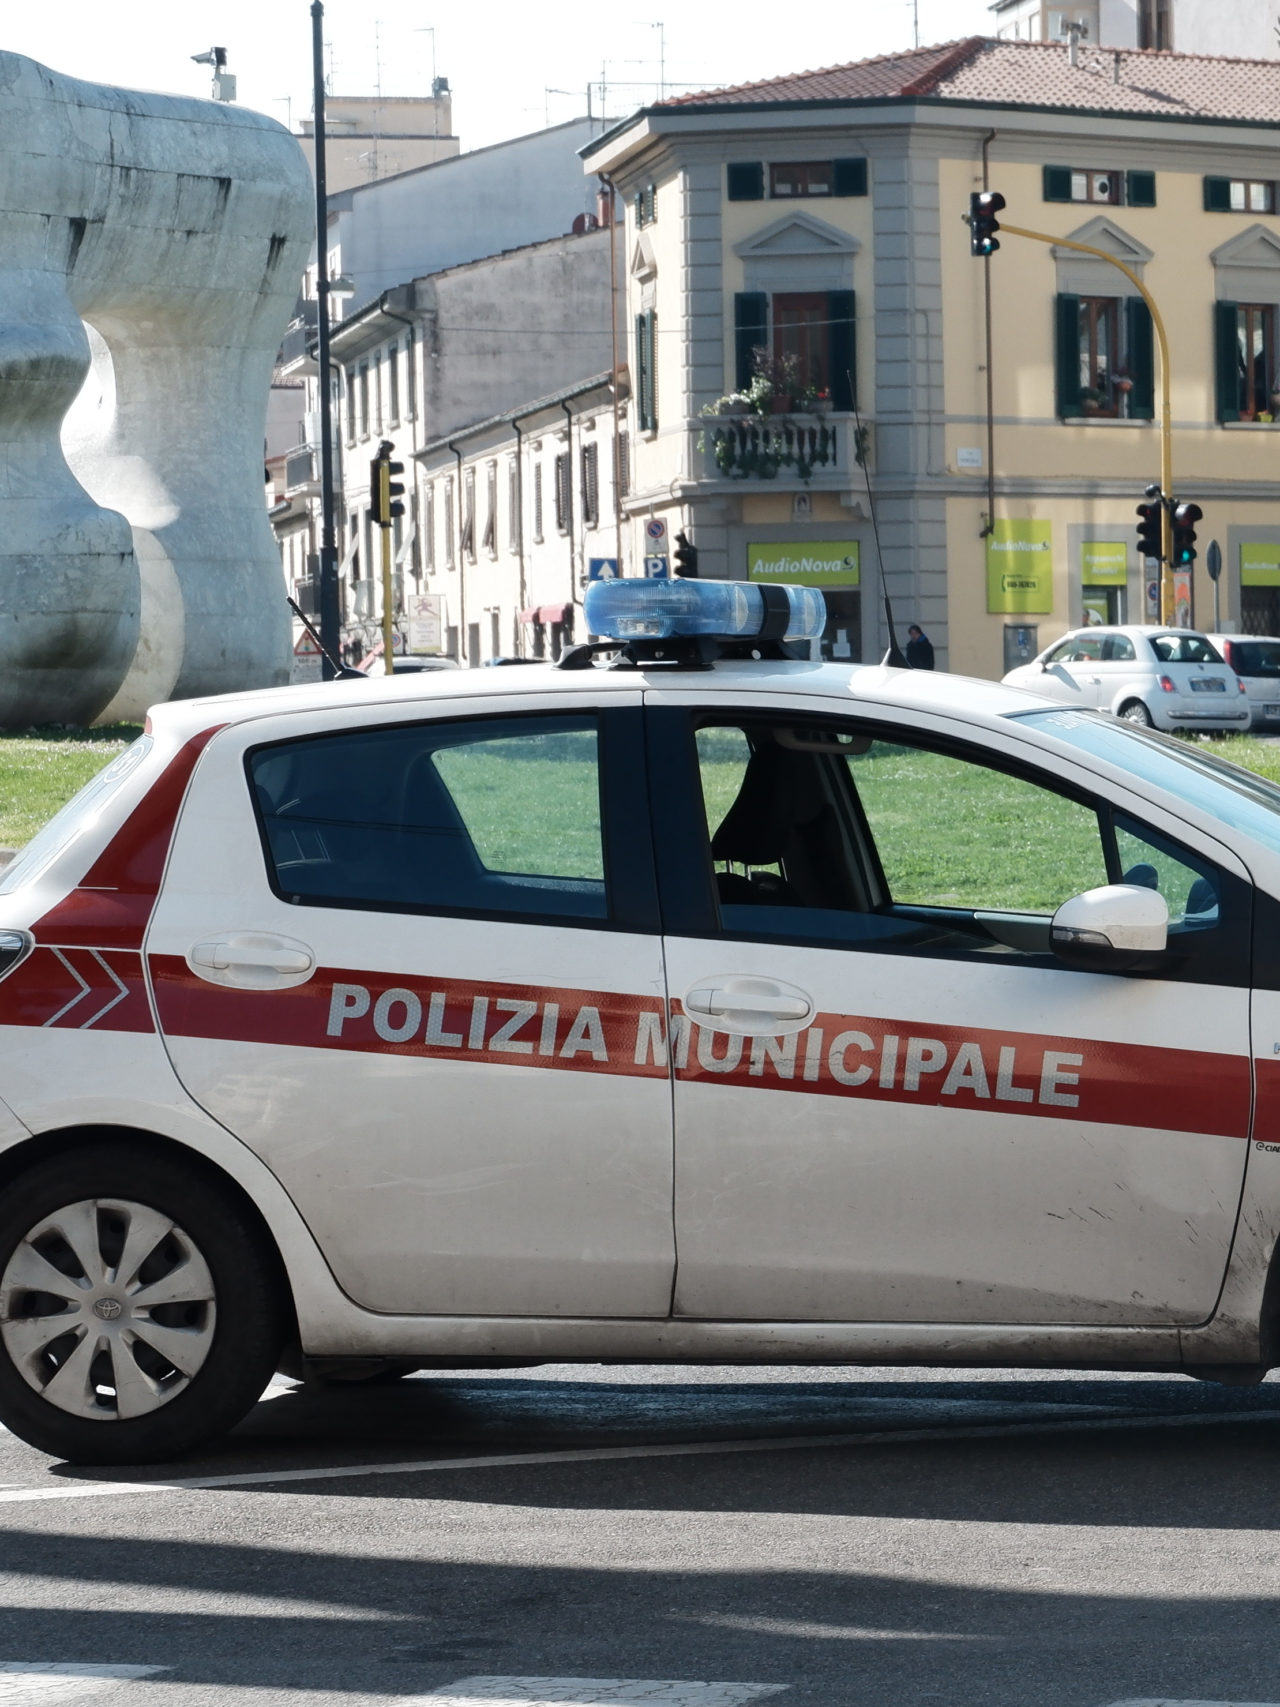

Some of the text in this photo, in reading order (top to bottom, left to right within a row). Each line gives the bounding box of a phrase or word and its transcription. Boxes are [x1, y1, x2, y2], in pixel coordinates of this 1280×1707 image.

[752, 557, 842, 574] AudioNova
[326, 983, 1083, 1108] POLIZIA MUNICIPALE
